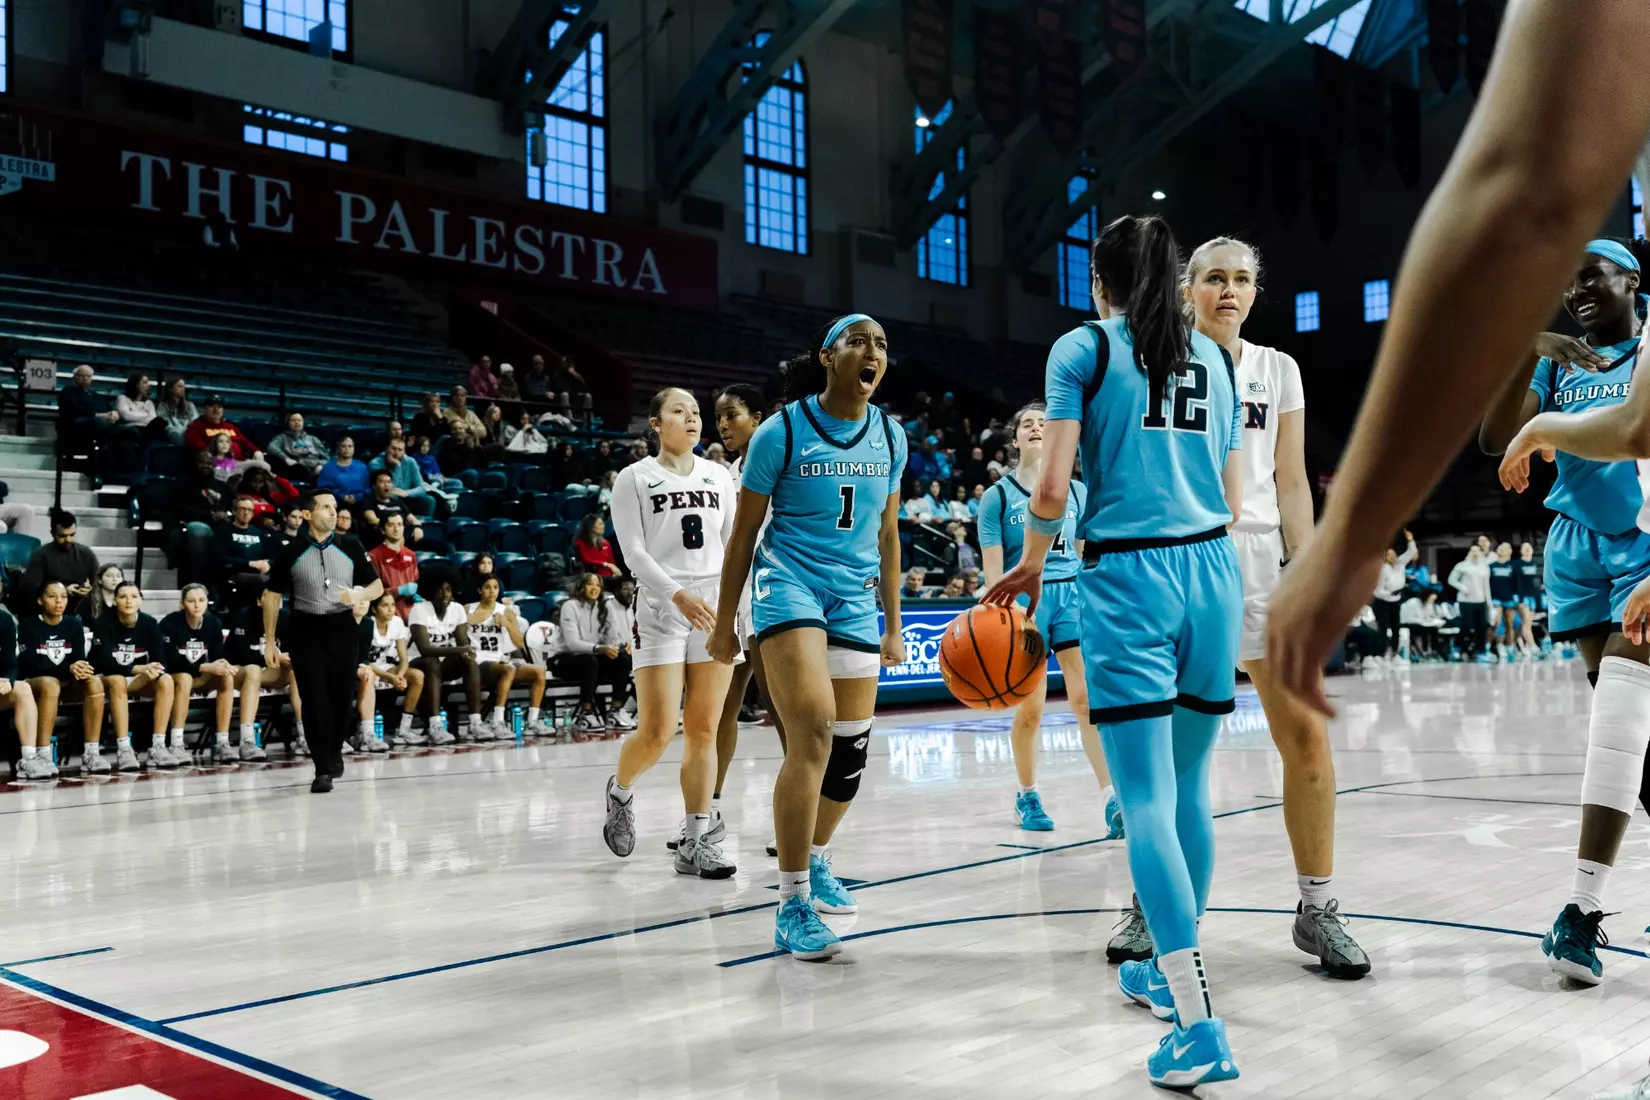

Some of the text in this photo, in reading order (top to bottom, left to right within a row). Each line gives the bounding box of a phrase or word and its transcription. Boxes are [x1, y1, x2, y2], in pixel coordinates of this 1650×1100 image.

[121, 150, 668, 294] THE PALESTRA
[31, 368, 52, 379] 103
[1141, 354, 1209, 434] 12
[800, 462, 889, 477] COLUMBIA
[650, 491, 720, 514] PENN
[836, 484, 856, 531] 1
[681, 514, 704, 550] 8
[1050, 524, 1067, 556] 4
[471, 624, 502, 634] PENN
[480, 636, 499, 652] 22
